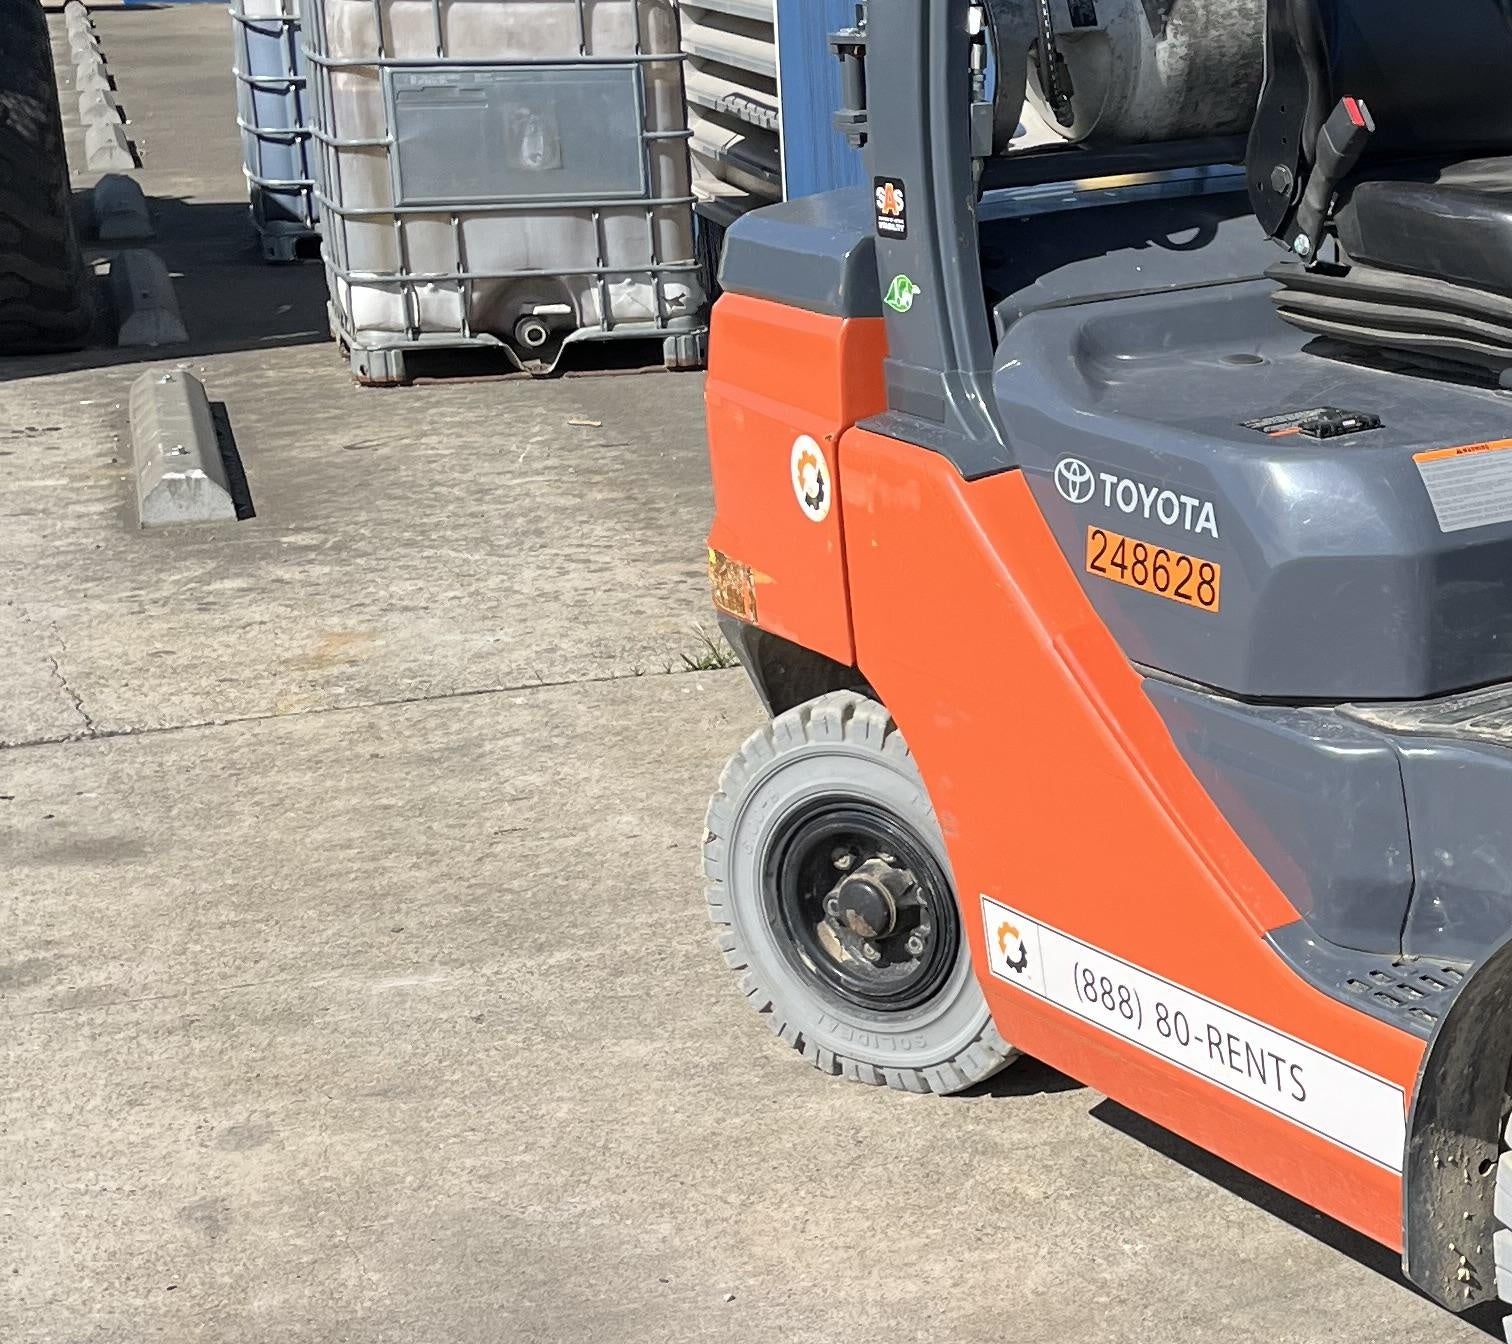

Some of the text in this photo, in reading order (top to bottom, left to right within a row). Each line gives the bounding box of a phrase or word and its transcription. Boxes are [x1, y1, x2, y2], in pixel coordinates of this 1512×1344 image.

[875, 182, 905, 216] SAS
[1099, 472, 1219, 539] TOYOTA
[1089, 529, 1216, 607] 248628
[1074, 960, 1308, 1103] (888) 80-RENTS
